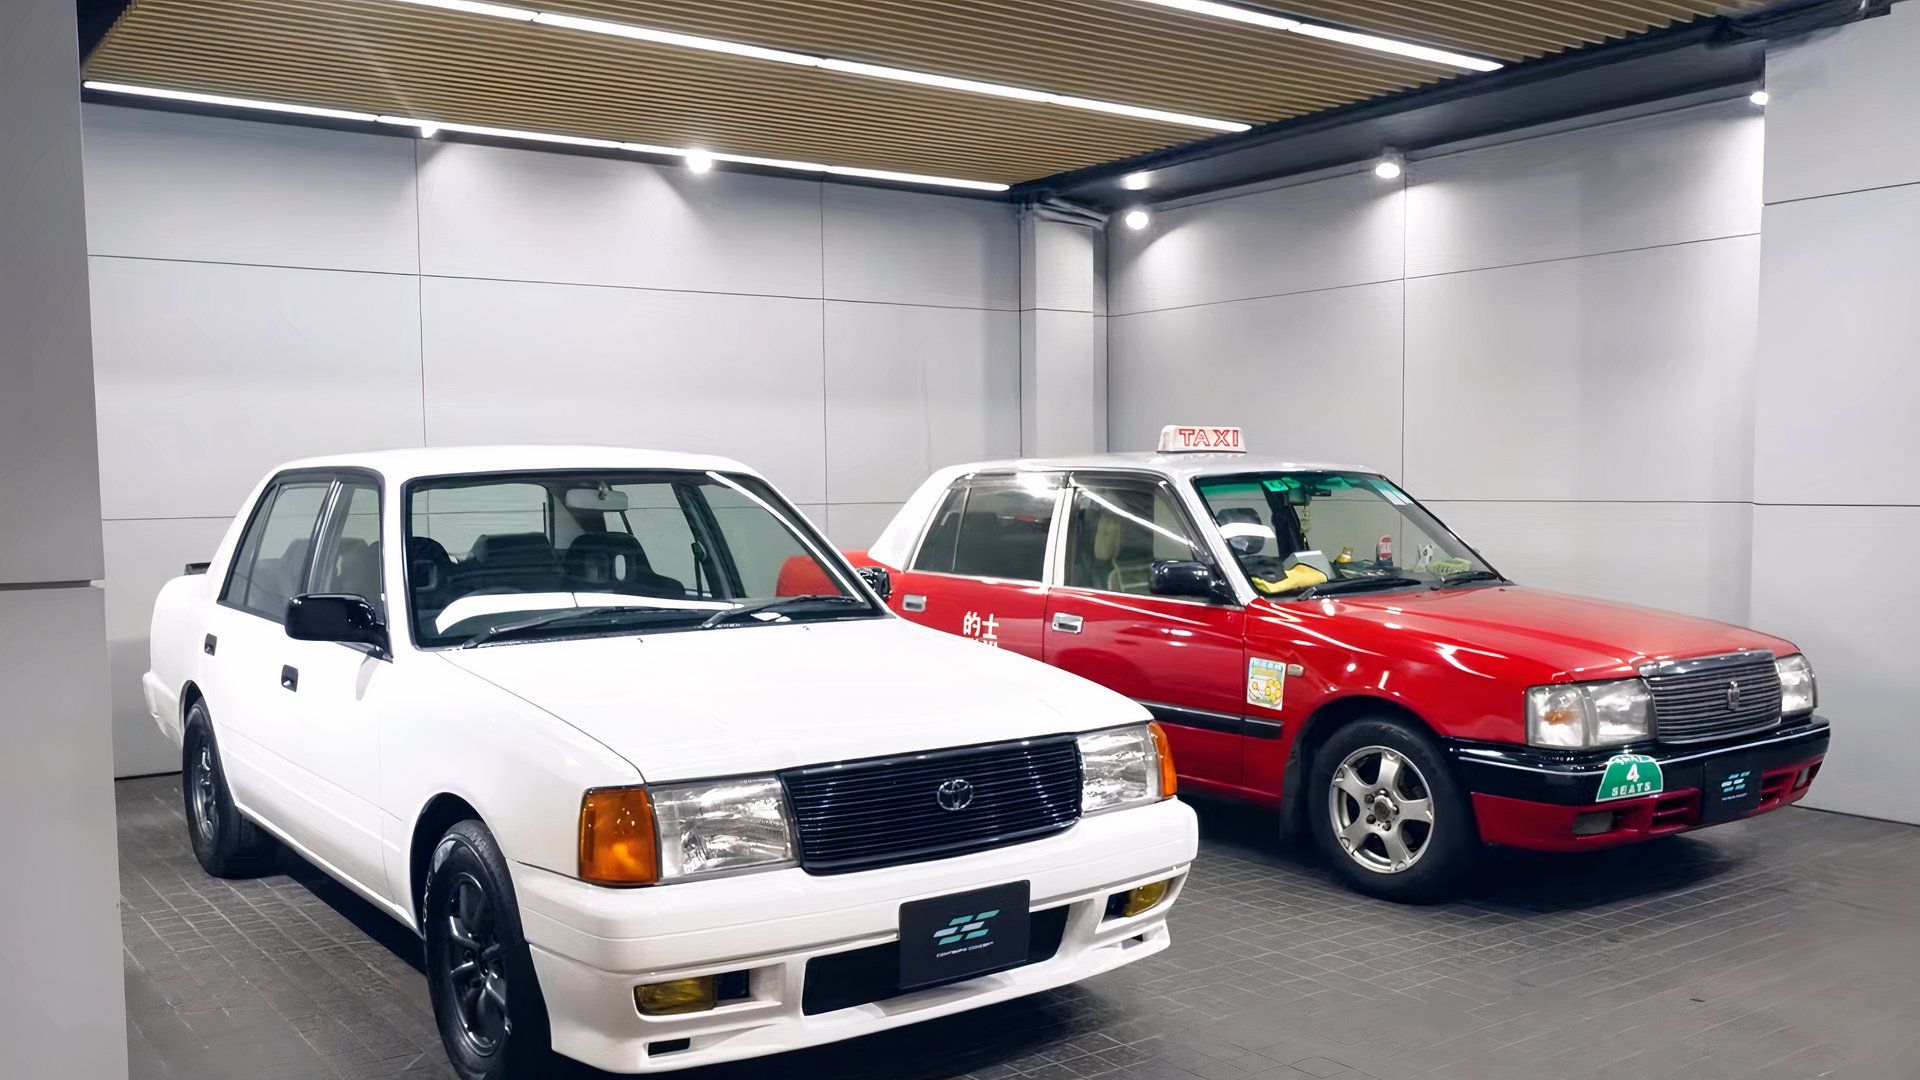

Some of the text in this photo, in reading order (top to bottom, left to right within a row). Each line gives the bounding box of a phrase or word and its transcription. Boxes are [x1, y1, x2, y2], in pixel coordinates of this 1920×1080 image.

[1179, 429, 1239, 446] TAXI
[963, 611, 999, 639] 的士
[1626, 763, 1640, 782] 4
[1611, 782, 1651, 797] SEATS
